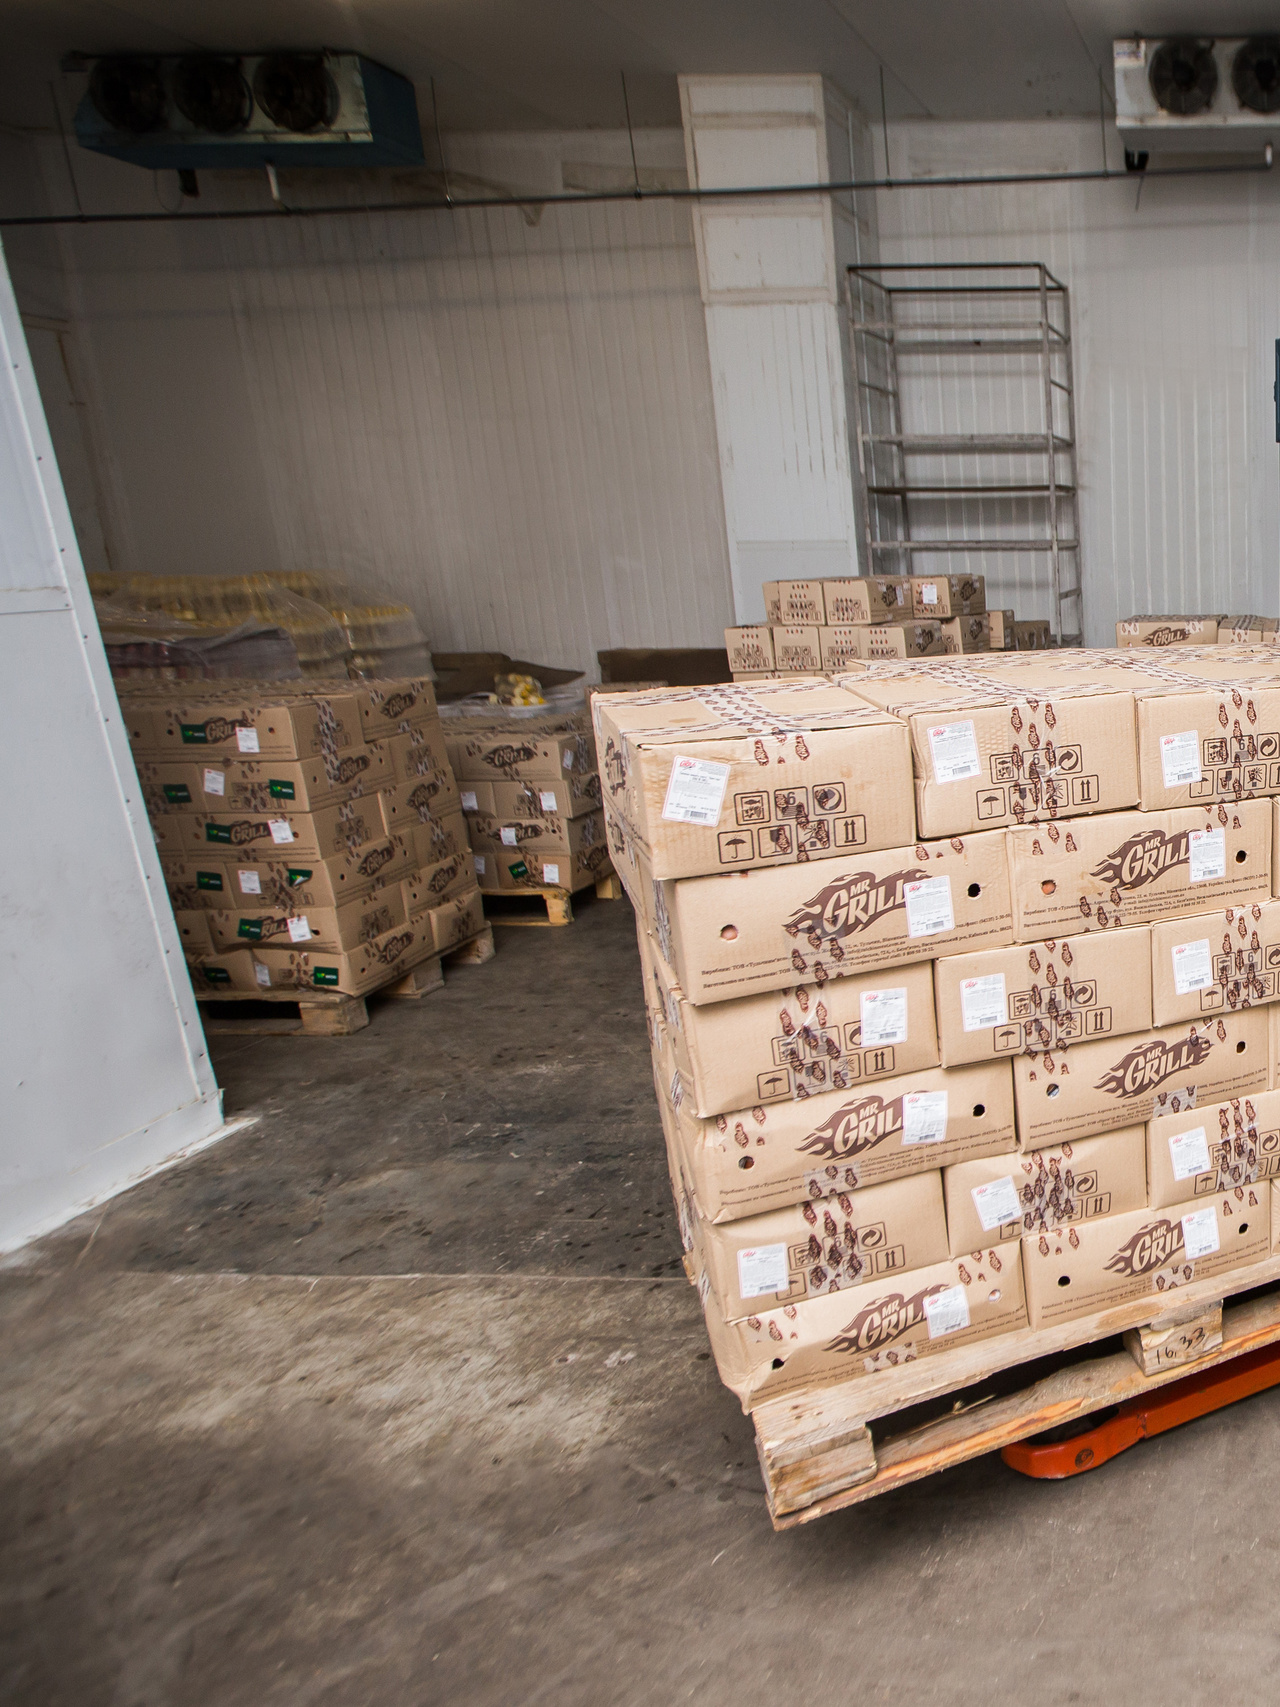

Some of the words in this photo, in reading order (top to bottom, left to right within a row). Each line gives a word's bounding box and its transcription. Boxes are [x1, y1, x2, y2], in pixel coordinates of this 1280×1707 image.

[1153, 631, 1183, 646] GRILL
[786, 791, 796, 805] 6
[1144, 836, 1161, 852] MR
[850, 879, 870, 897] MR
[823, 879, 905, 933] GRILL
[1146, 1046, 1162, 1062] MR
[1124, 1045, 1195, 1093] GRILL
[860, 1102, 880, 1120] MR
[834, 1107, 903, 1154] GRIL
[1152, 1224, 1167, 1241] MR
[1132, 1227, 1184, 1272] GRIL
[882, 1298, 900, 1319] MR
